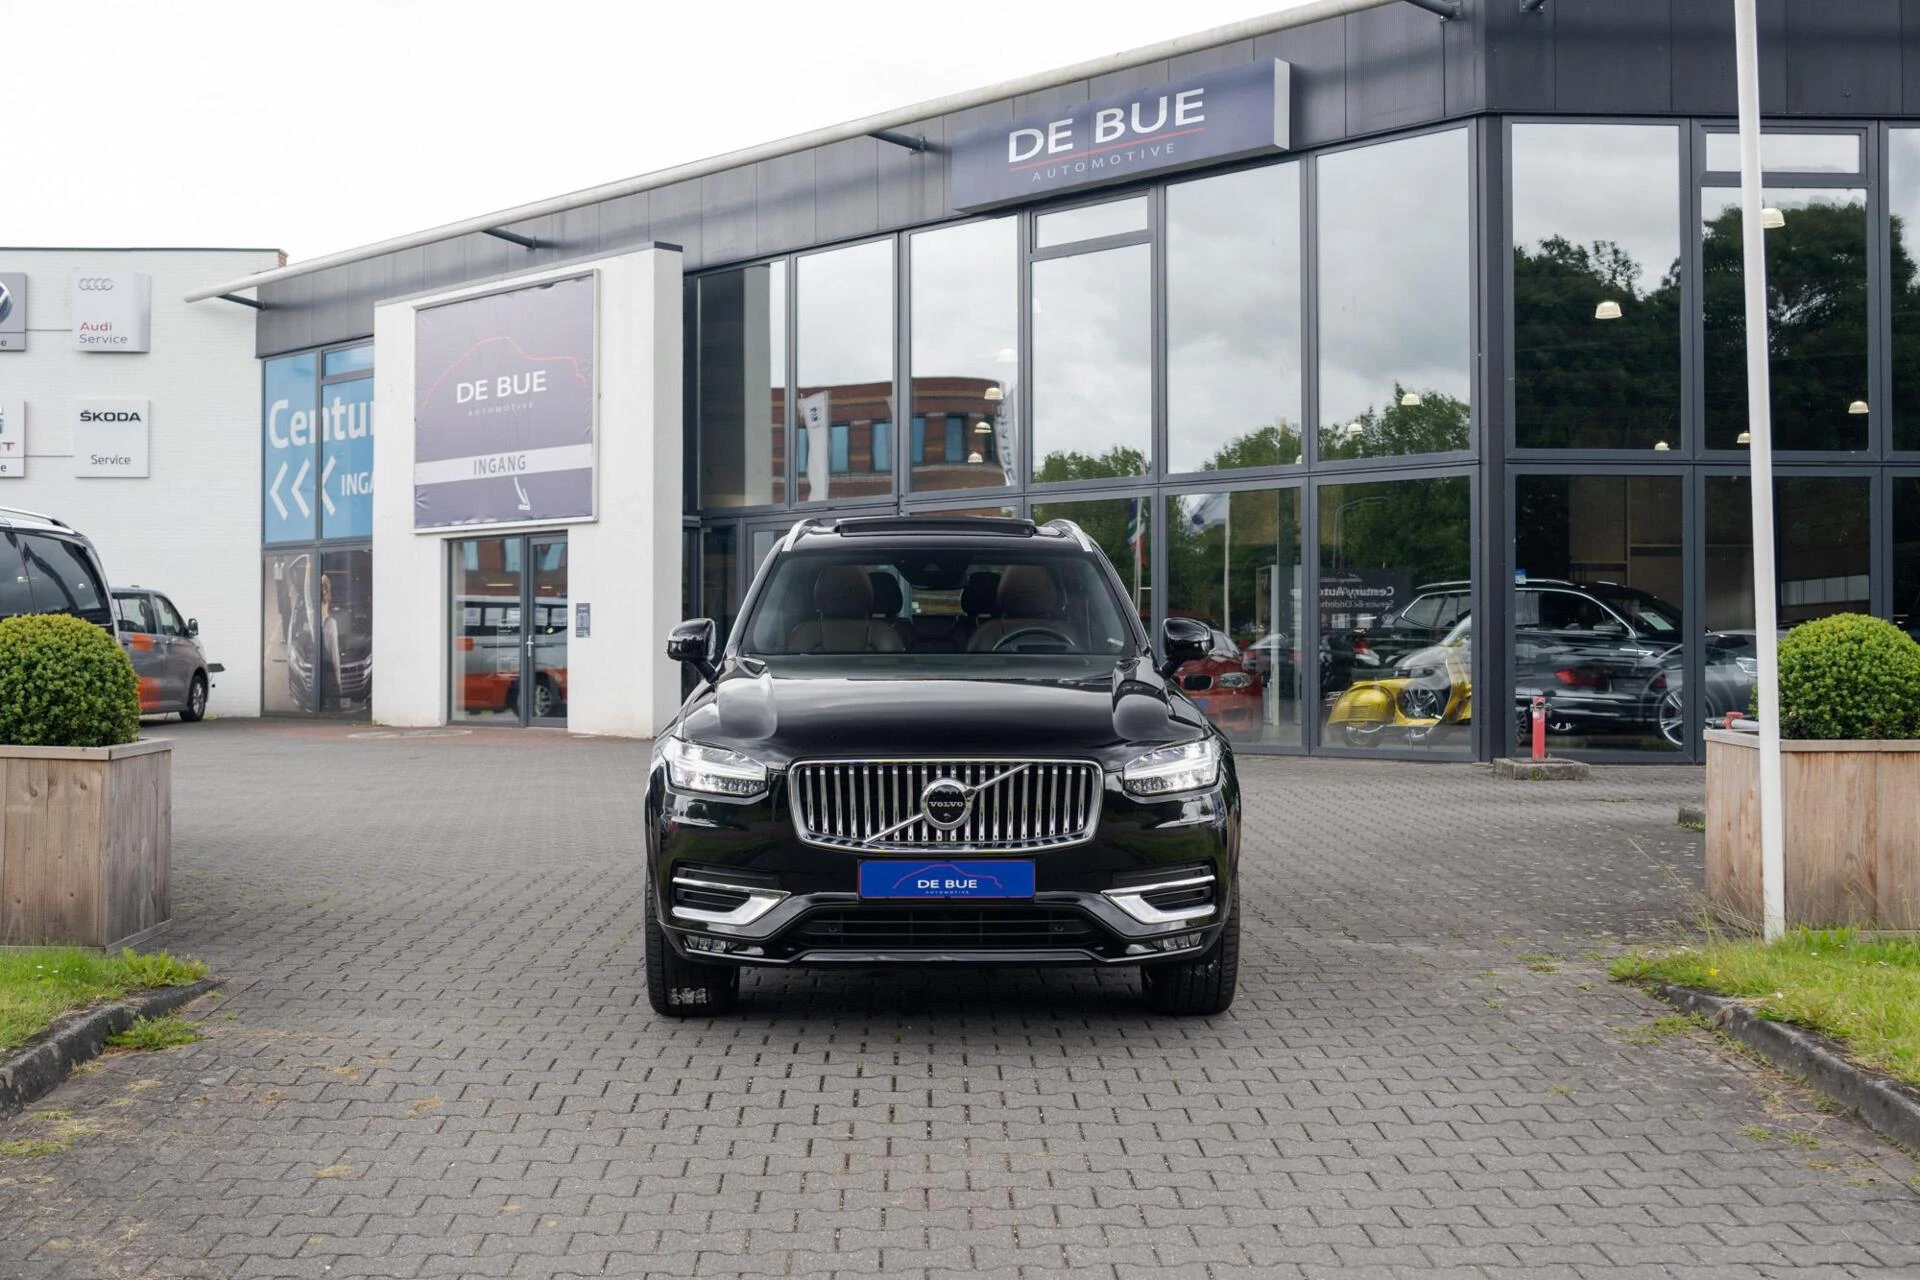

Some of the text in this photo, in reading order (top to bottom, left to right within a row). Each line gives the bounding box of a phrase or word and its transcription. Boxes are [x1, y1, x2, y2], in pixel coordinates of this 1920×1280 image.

[1008, 88, 1206, 163] DE BUE
[1032, 143, 1175, 183] AUTOMOTIVE
[79, 321, 113, 331] Audi
[79, 334, 128, 344] Service
[456, 369, 547, 404] DE BUE
[80, 410, 141, 422] ŠKODA
[90, 454, 132, 465] Service
[473, 454, 527, 475] INGANG
[917, 880, 978, 889] DE BUE
